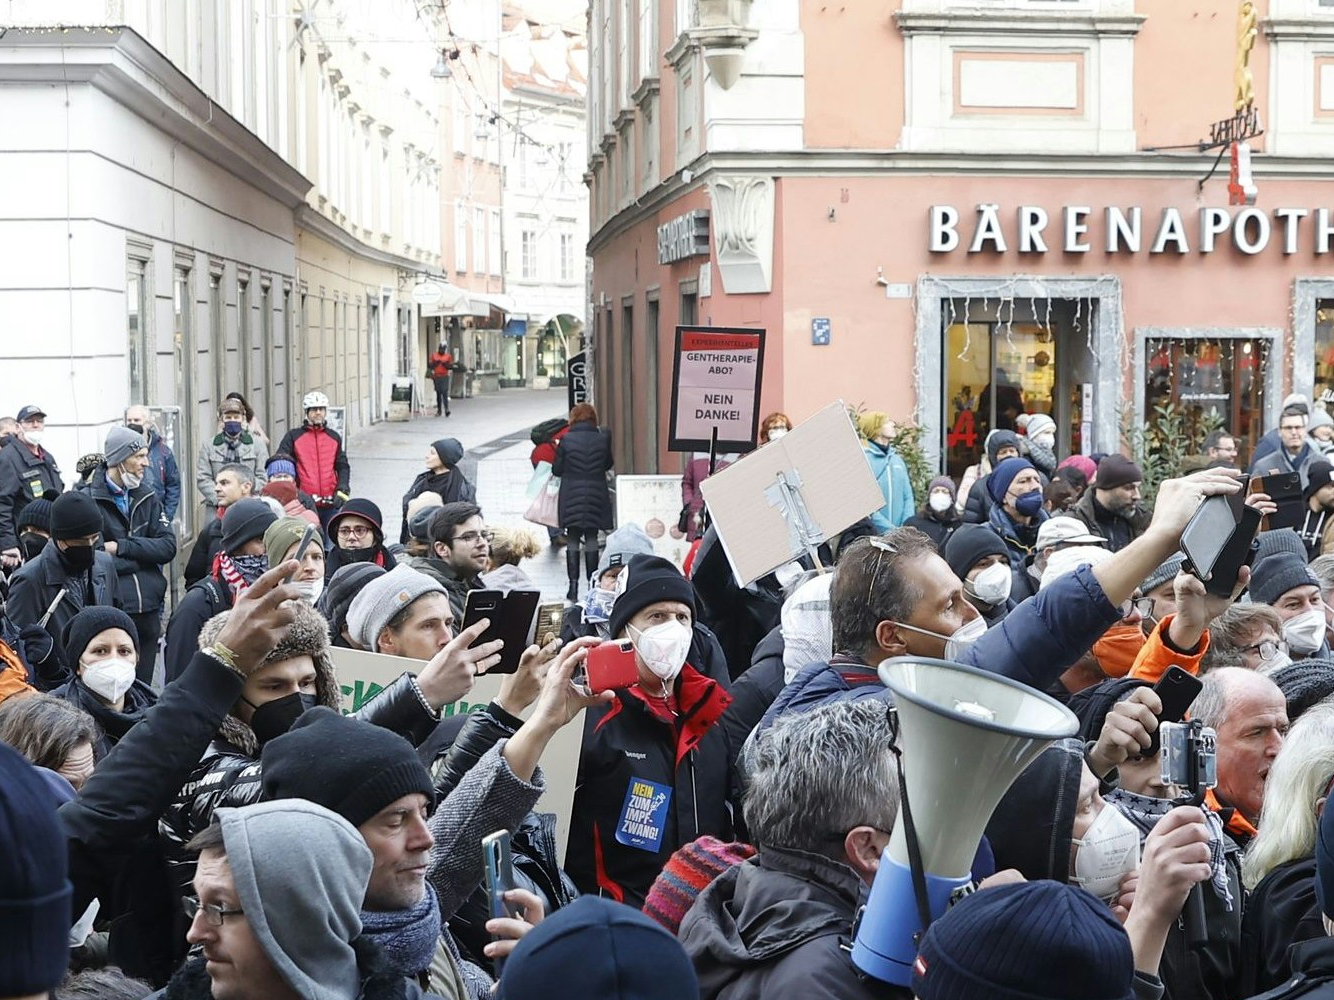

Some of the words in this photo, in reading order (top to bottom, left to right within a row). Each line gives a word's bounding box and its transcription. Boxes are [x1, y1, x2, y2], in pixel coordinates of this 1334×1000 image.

[686, 352, 756, 364] GENTHERAPIE-
[708, 366, 734, 375] ABO?
[703, 394, 734, 405] NEIN
[695, 408, 740, 421] DANKE!
[633, 782, 654, 799] NEIN
[628, 795, 652, 812] ZUM
[625, 807, 653, 825] IMPF-
[621, 819, 659, 841] ZWANG!
